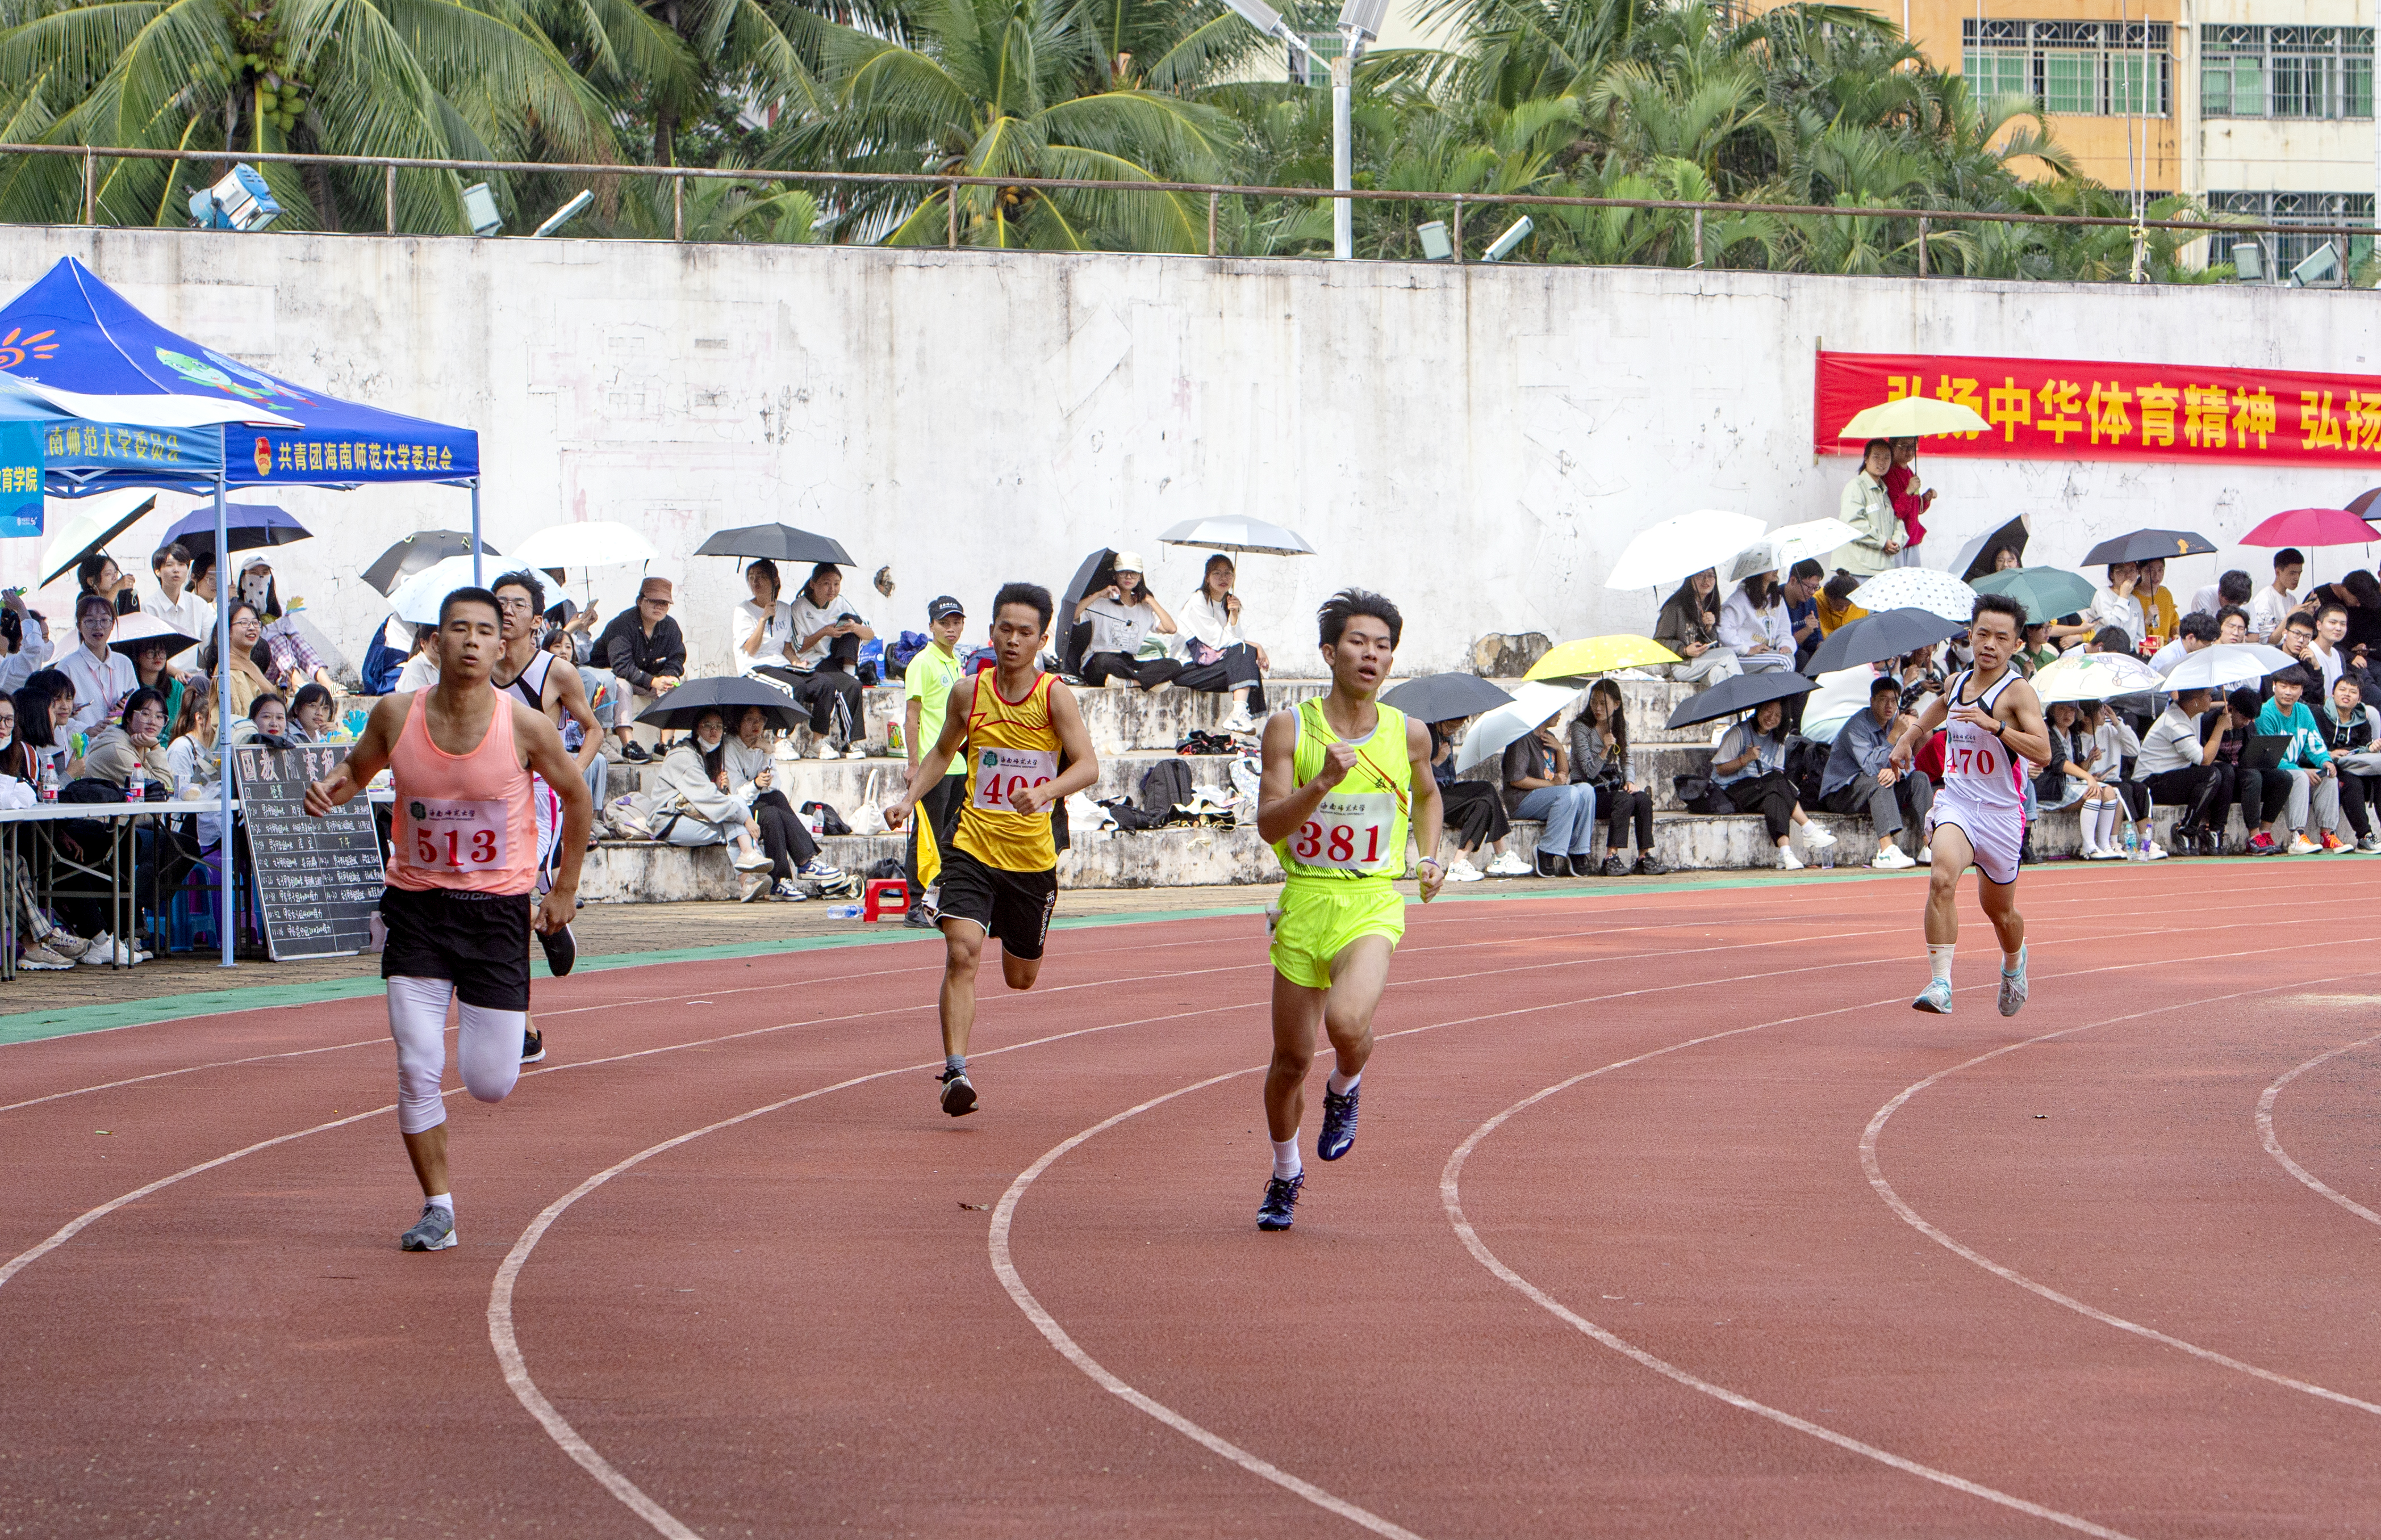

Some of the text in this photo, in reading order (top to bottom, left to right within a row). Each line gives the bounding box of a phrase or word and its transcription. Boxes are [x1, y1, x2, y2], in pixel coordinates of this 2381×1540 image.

[45, 426, 182, 462] 南师范大学委员会
[278, 442, 453, 471] 共青团海南师范大学委员会
[0, 466, 38, 493] 育学院
[240, 747, 352, 782] 国教院赛程
[1000, 756, 1038, 765] 海南师范大学
[1947, 748, 1995, 775] 470
[1320, 801, 1365, 812] 海南师范大学
[417, 828, 497, 867] 513
[1296, 821, 1380, 863] 381
